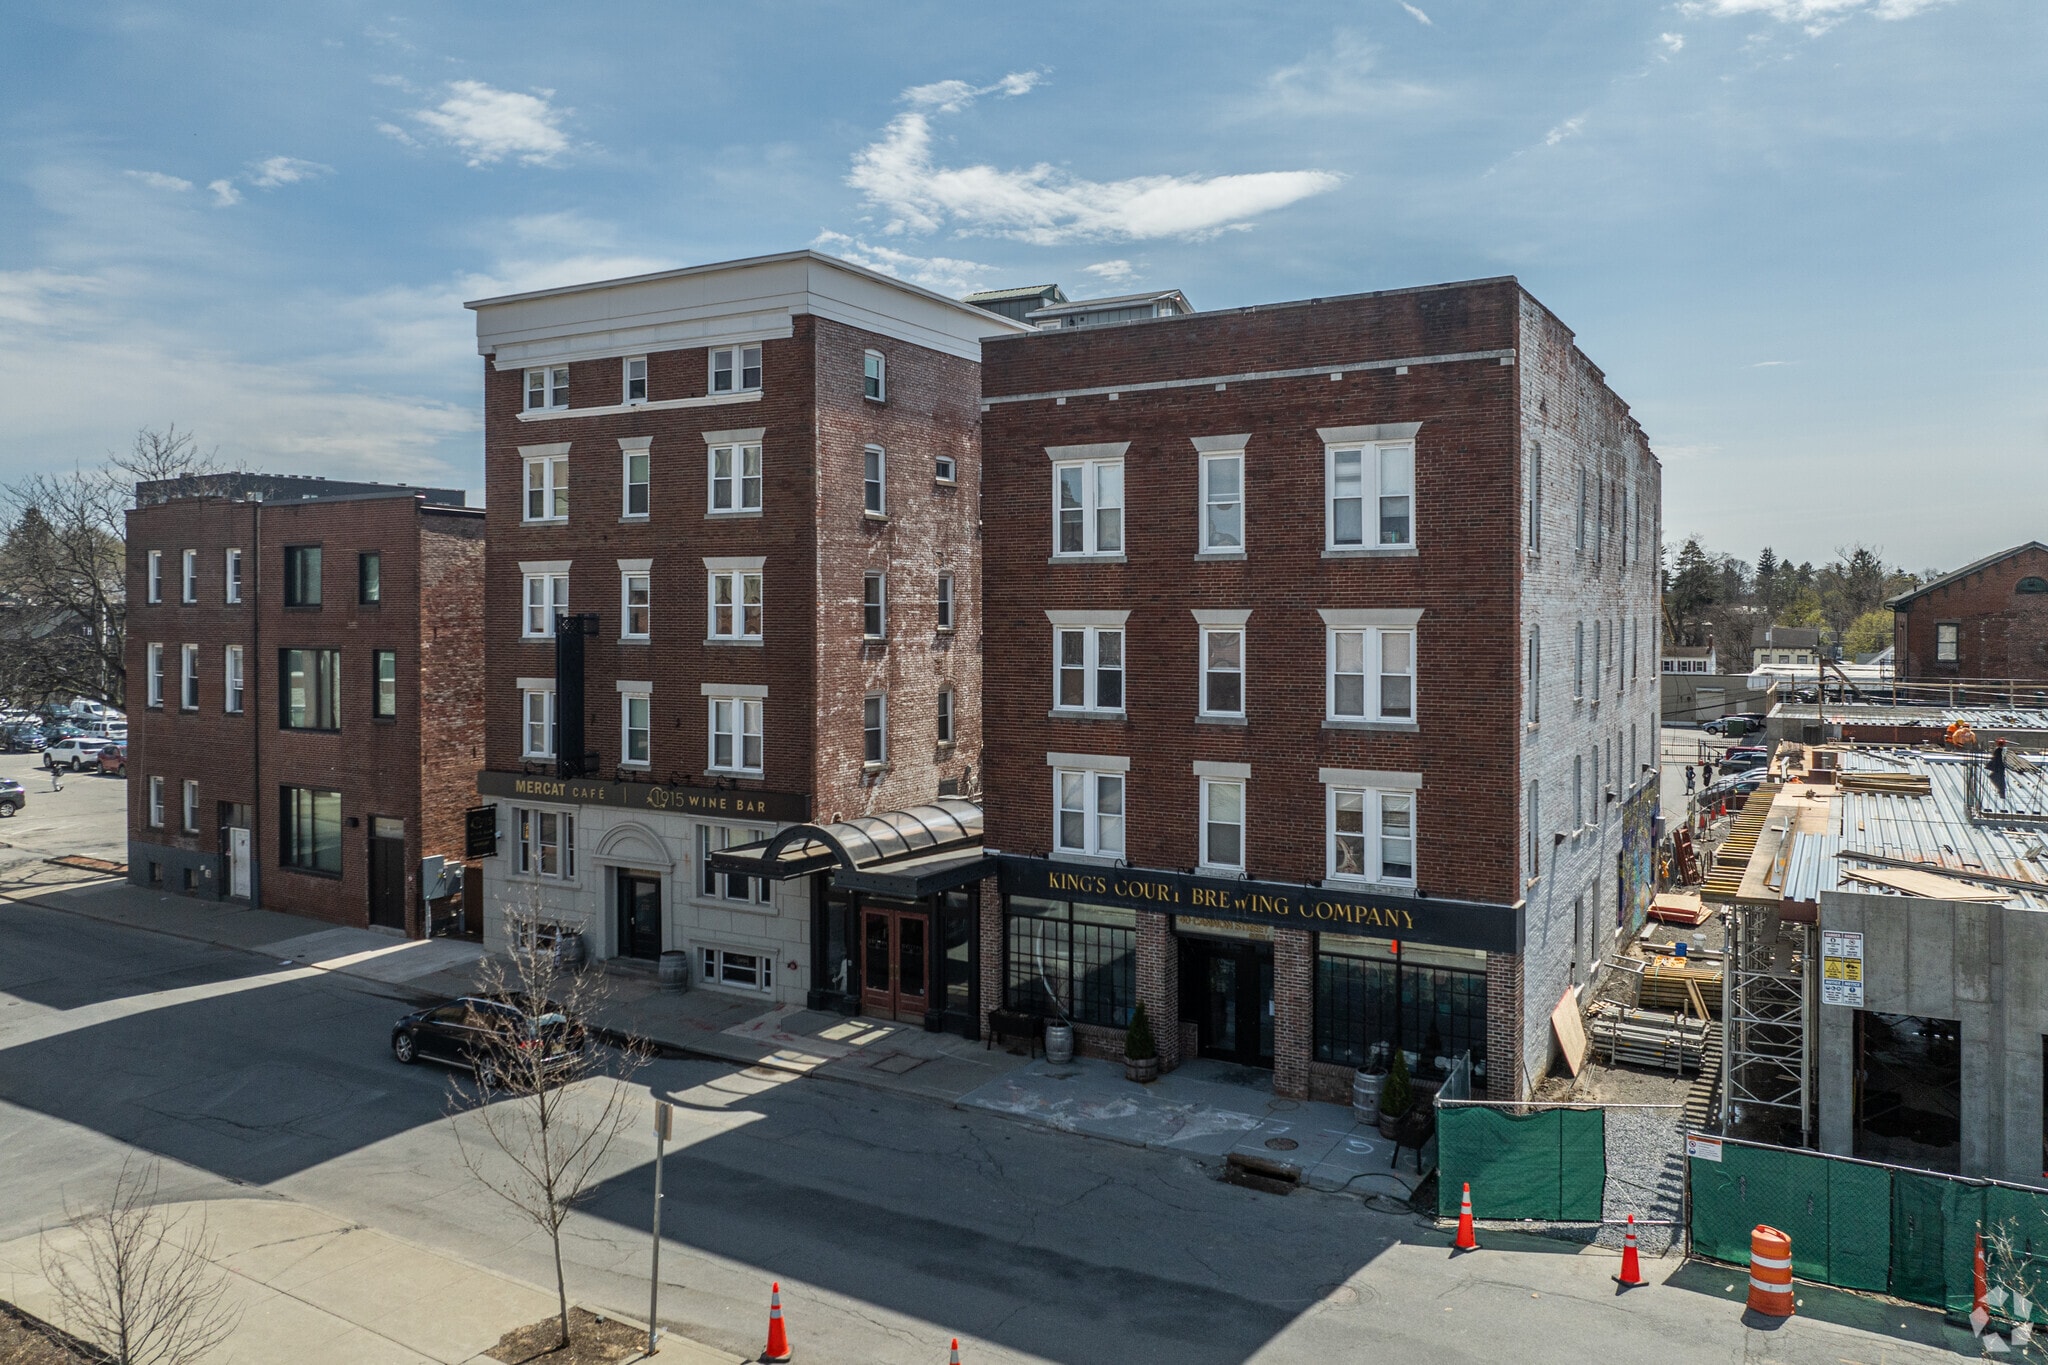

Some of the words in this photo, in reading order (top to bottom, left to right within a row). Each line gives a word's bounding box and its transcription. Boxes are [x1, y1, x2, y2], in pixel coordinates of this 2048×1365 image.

[515, 780, 566, 796] MERCAT
[572, 786, 605, 800] CAFÉ
[654, 790, 685, 808] 1915
[688, 795, 727, 809] WINE
[736, 799, 766, 813] BAR
[1049, 872, 1106, 894] KING'S
[1235, 922, 1269, 934] STREET
